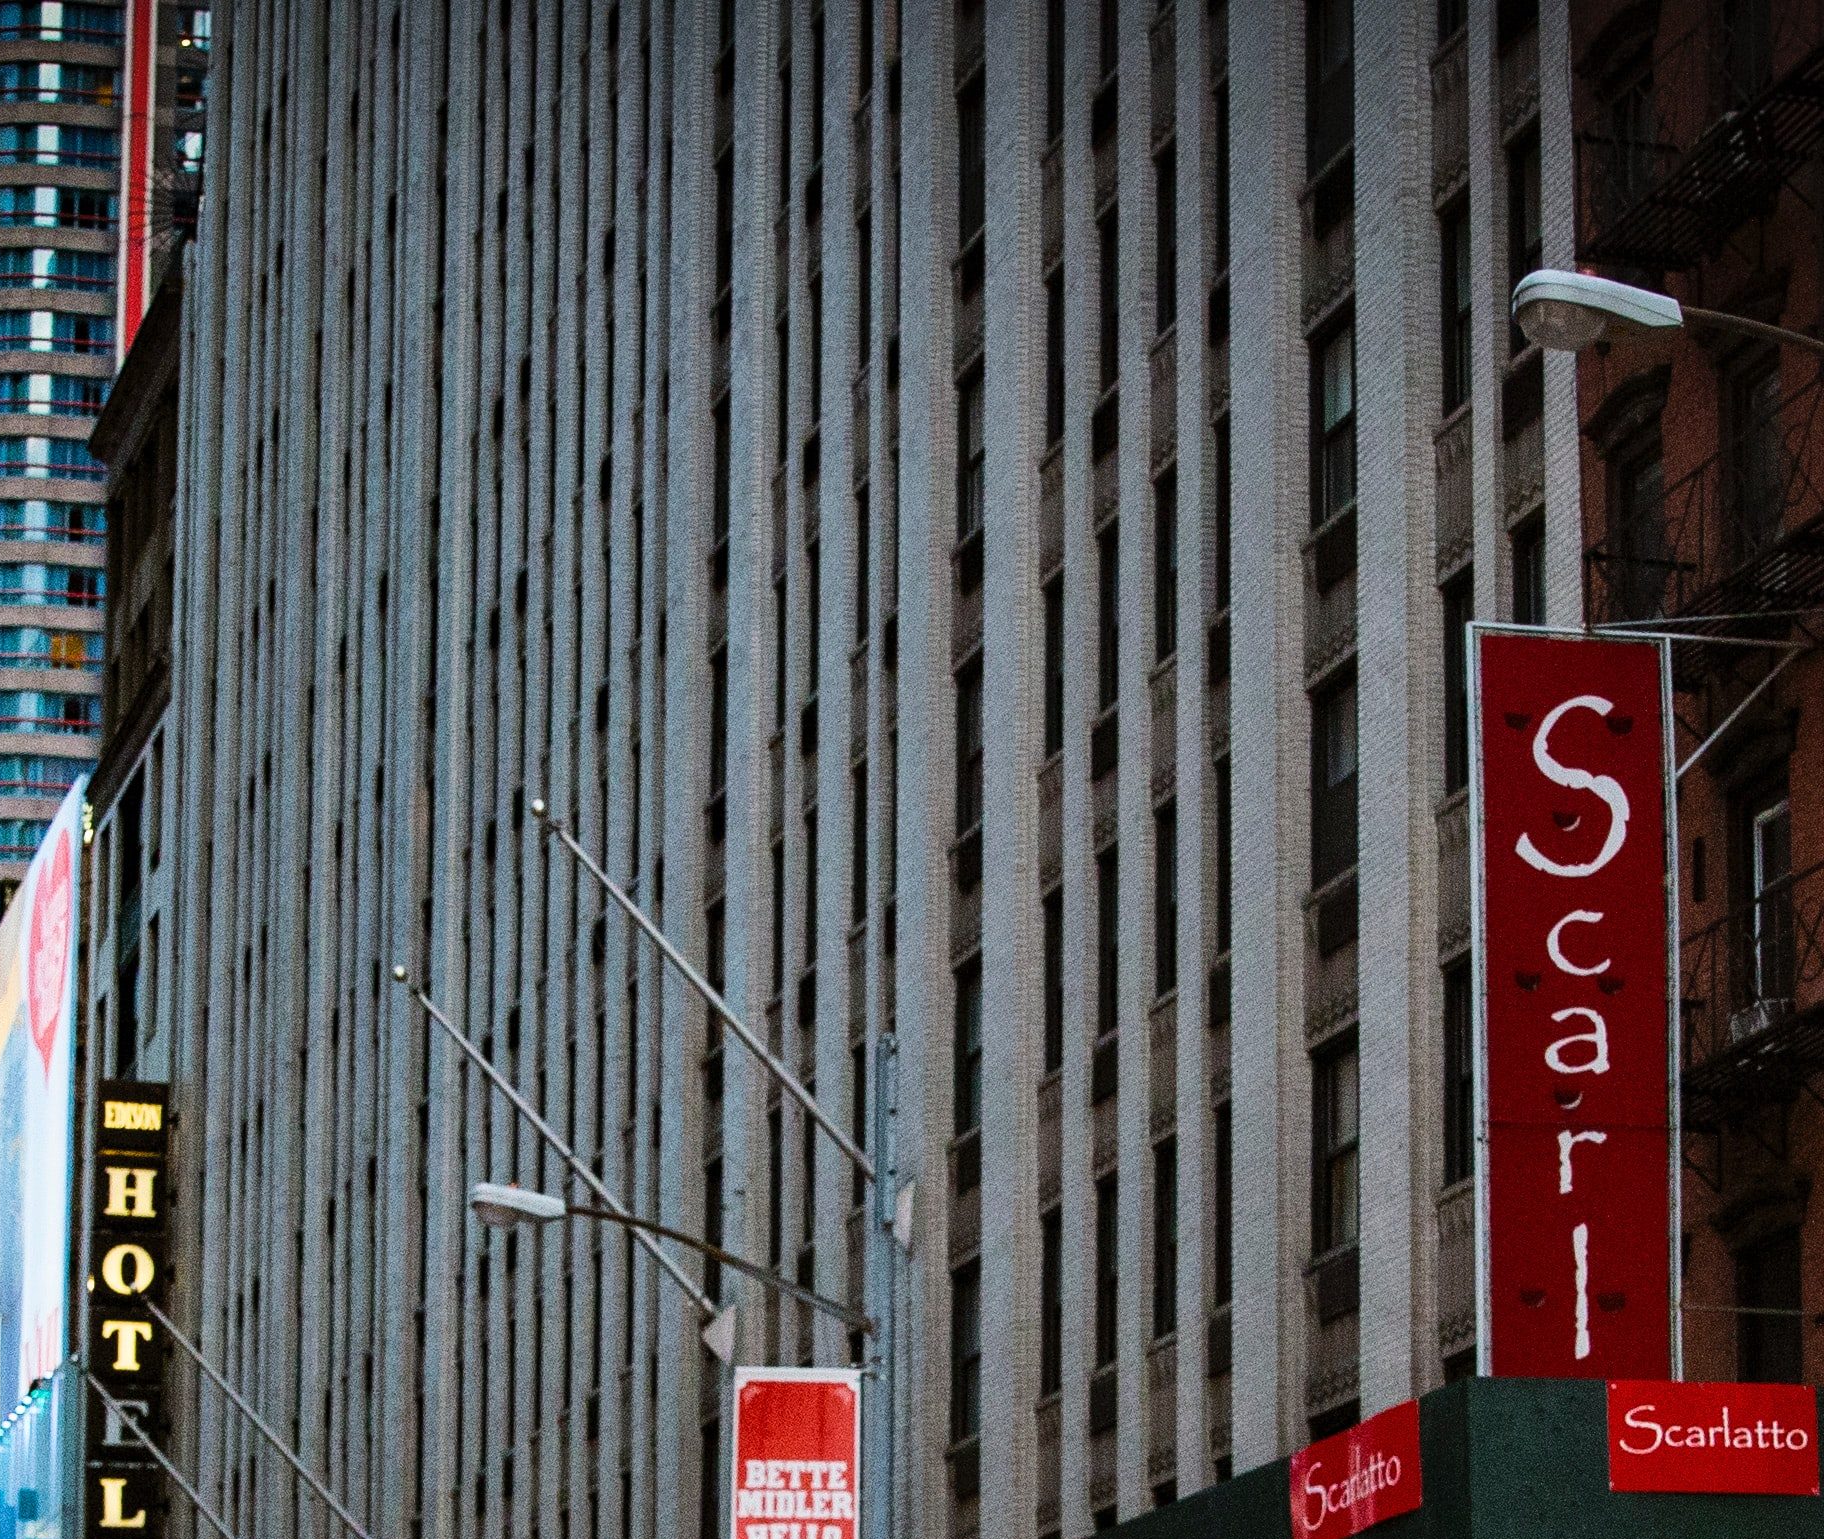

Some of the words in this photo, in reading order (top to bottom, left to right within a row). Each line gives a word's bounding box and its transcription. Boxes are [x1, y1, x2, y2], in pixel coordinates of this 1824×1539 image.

[1515, 694, 1630, 1359] Scarl
[104, 1100, 162, 1131] EDISON
[99, 1167, 157, 1528] HOTEL
[1619, 1404, 1809, 1455] Scarlatto
[745, 1460, 848, 1489] BETTE
[1301, 1452, 1402, 1533] Scarlatto
[738, 1489, 854, 1519] MIDLER
